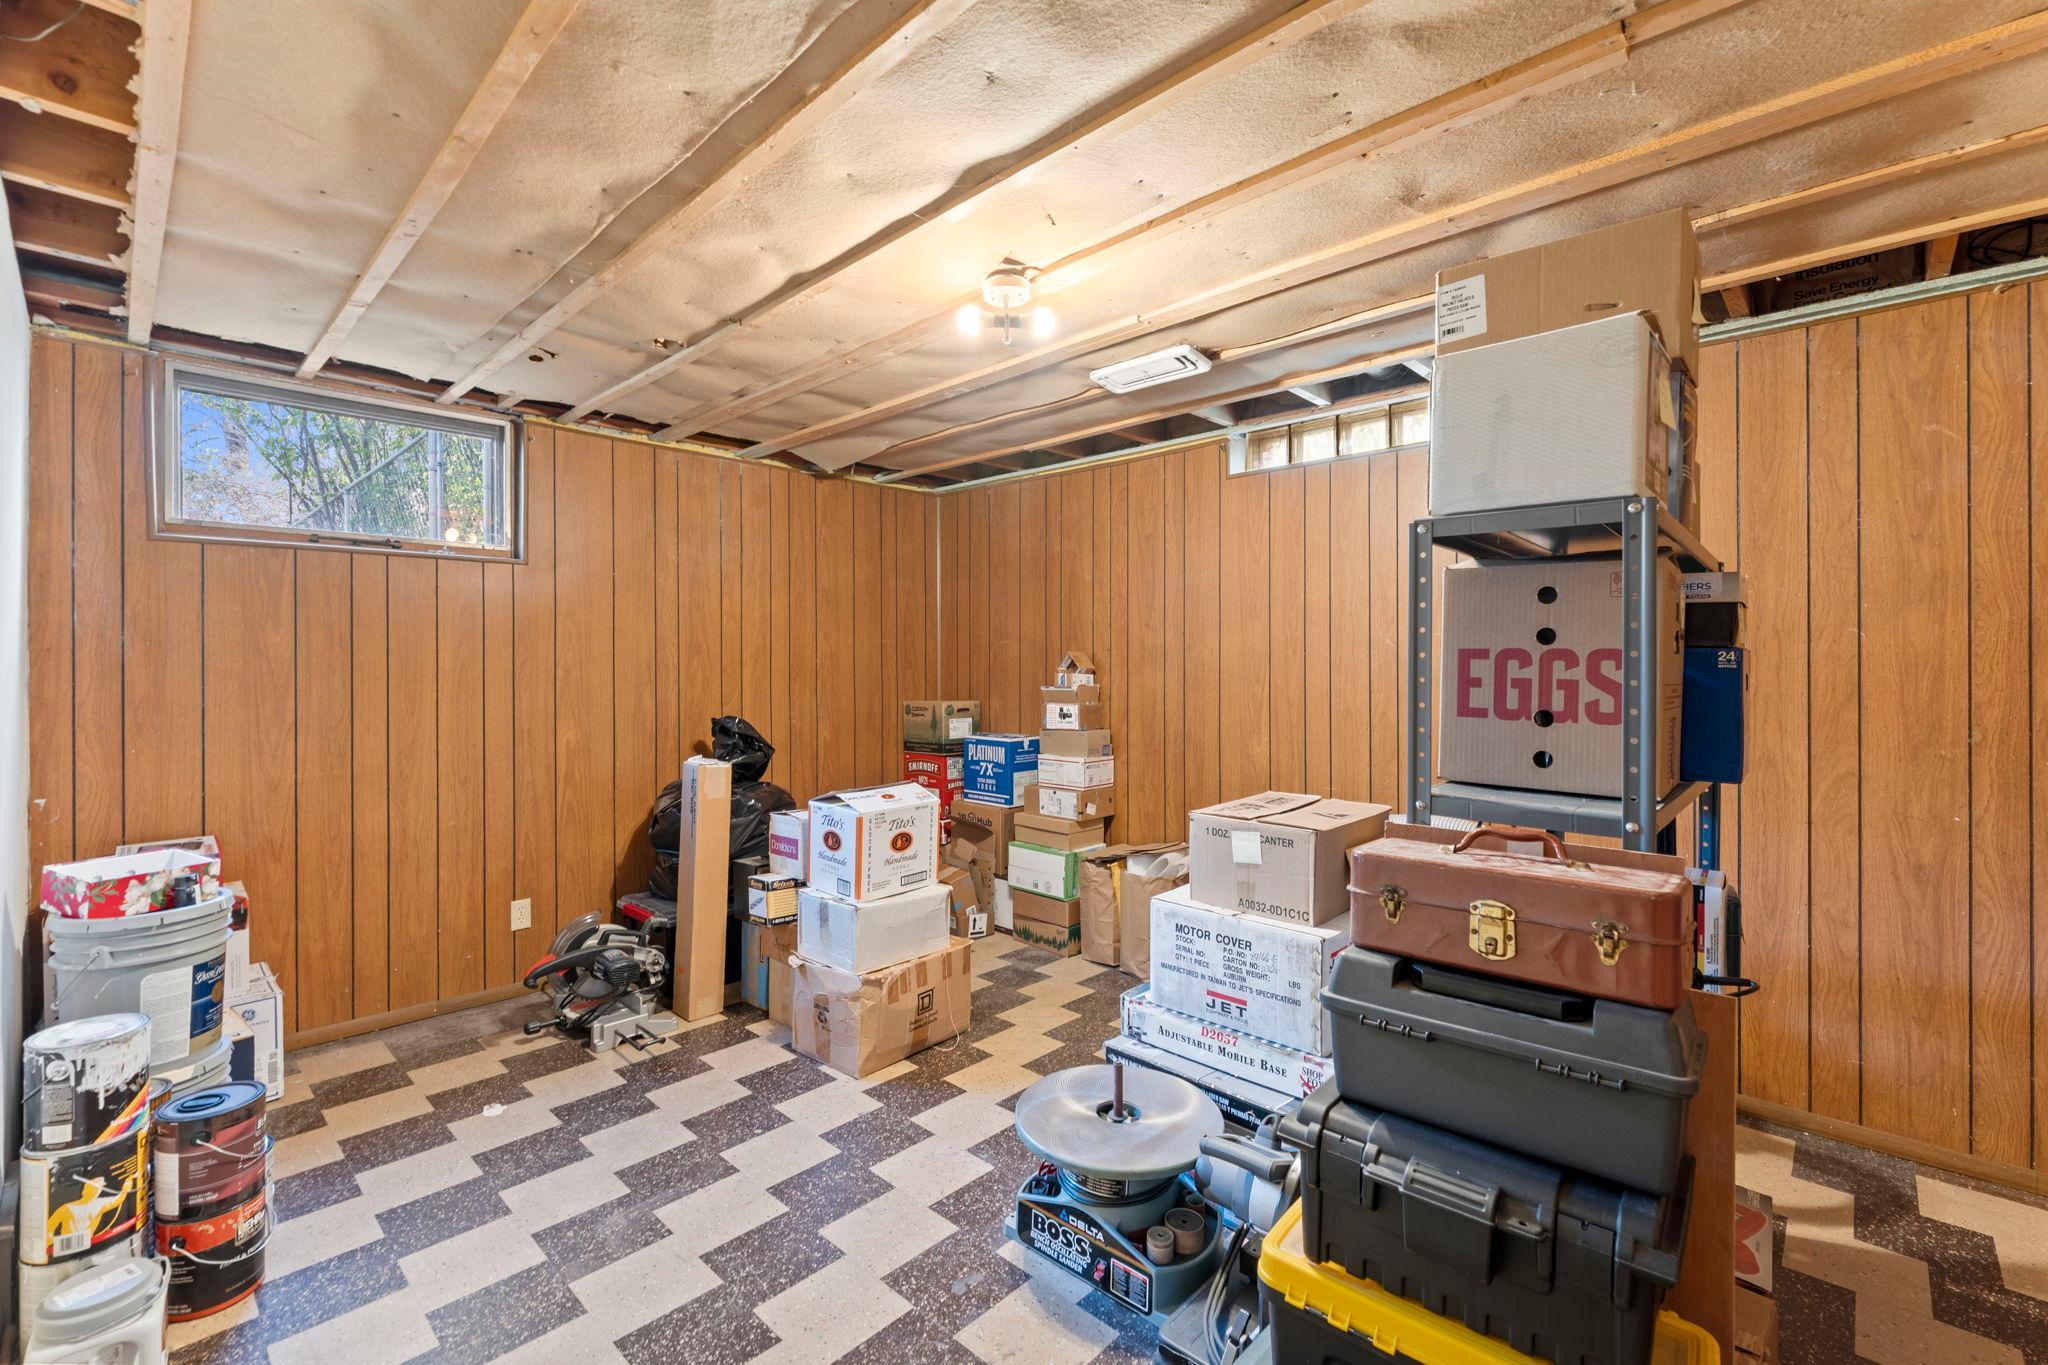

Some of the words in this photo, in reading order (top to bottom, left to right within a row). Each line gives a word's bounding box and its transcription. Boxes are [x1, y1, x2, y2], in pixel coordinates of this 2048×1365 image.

[1794, 286, 1827, 301] Save
[1830, 273, 1880, 293] Energy
[1718, 651, 1736, 661] 24
[1456, 648, 1622, 726] EGGS
[968, 743, 1006, 765] PLATINUM
[908, 761, 939, 773] SMIRNOFF
[979, 762, 994, 777] 7X
[976, 782, 997, 791] VODKA
[821, 814, 845, 831] Tito's
[889, 815, 916, 832] Tito's
[977, 815, 993, 827] Hub
[1212, 828, 1231, 839] DOZ.
[771, 839, 797, 855] Donaldsons
[817, 850, 848, 867] Handmade
[883, 850, 919, 867] Handmade
[773, 879, 795, 889] Grizzly
[1238, 898, 1310, 922] A0032-0D1C1C
[1175, 923, 1211, 941] MOTOR
[1215, 933, 1252, 951] COVER
[1175, 935, 1196, 946] STOCK:
[1175, 944, 1195, 956] SERIAL
[1196, 949, 1206, 959] NO:
[1222, 947, 1235, 956] P.O.
[1236, 951, 1247, 960] NO:
[1175, 953, 1188, 964] QTY:
[1193, 958, 1210, 969] PIECE
[1222, 956, 1247, 967] CARTON
[1249, 962, 1260, 971] NO:
[1161, 962, 1199, 980] MANUFACTURED
[1207, 975, 1227, 987] TAIWAN
[1228, 980, 1236, 989] TO
[1238, 983, 1254, 994] JET'S
[1255, 988, 1302, 1007] SPECIFICATIONS
[1222, 963, 1243, 974] GROSS
[1245, 968, 1271, 983] WEIGHT:
[1288, 980, 1301, 990] LBS
[1222, 972, 1247, 983] AUBURN
[1205, 998, 1248, 1018] JET
[1205, 1007, 1229, 1018] EQUIPMENT
[1234, 1014, 1248, 1024] TOOLS
[1201, 1026, 1239, 1047] D2057
[1157, 1024, 1214, 1054] ADJUSTABLE
[1217, 1047, 1256, 1068] MOBILE
[1260, 1058, 1288, 1078] BASE
[1301, 1066, 1324, 1080] SHOP
[1068, 1214, 1105, 1243] DELTA
[1030, 1229, 1050, 1246] BENCH
[1050, 1241, 1088, 1268] OSCILLATING
[1034, 1240, 1058, 1259] SPINDLE
[1058, 1254, 1083, 1274] SANDER
